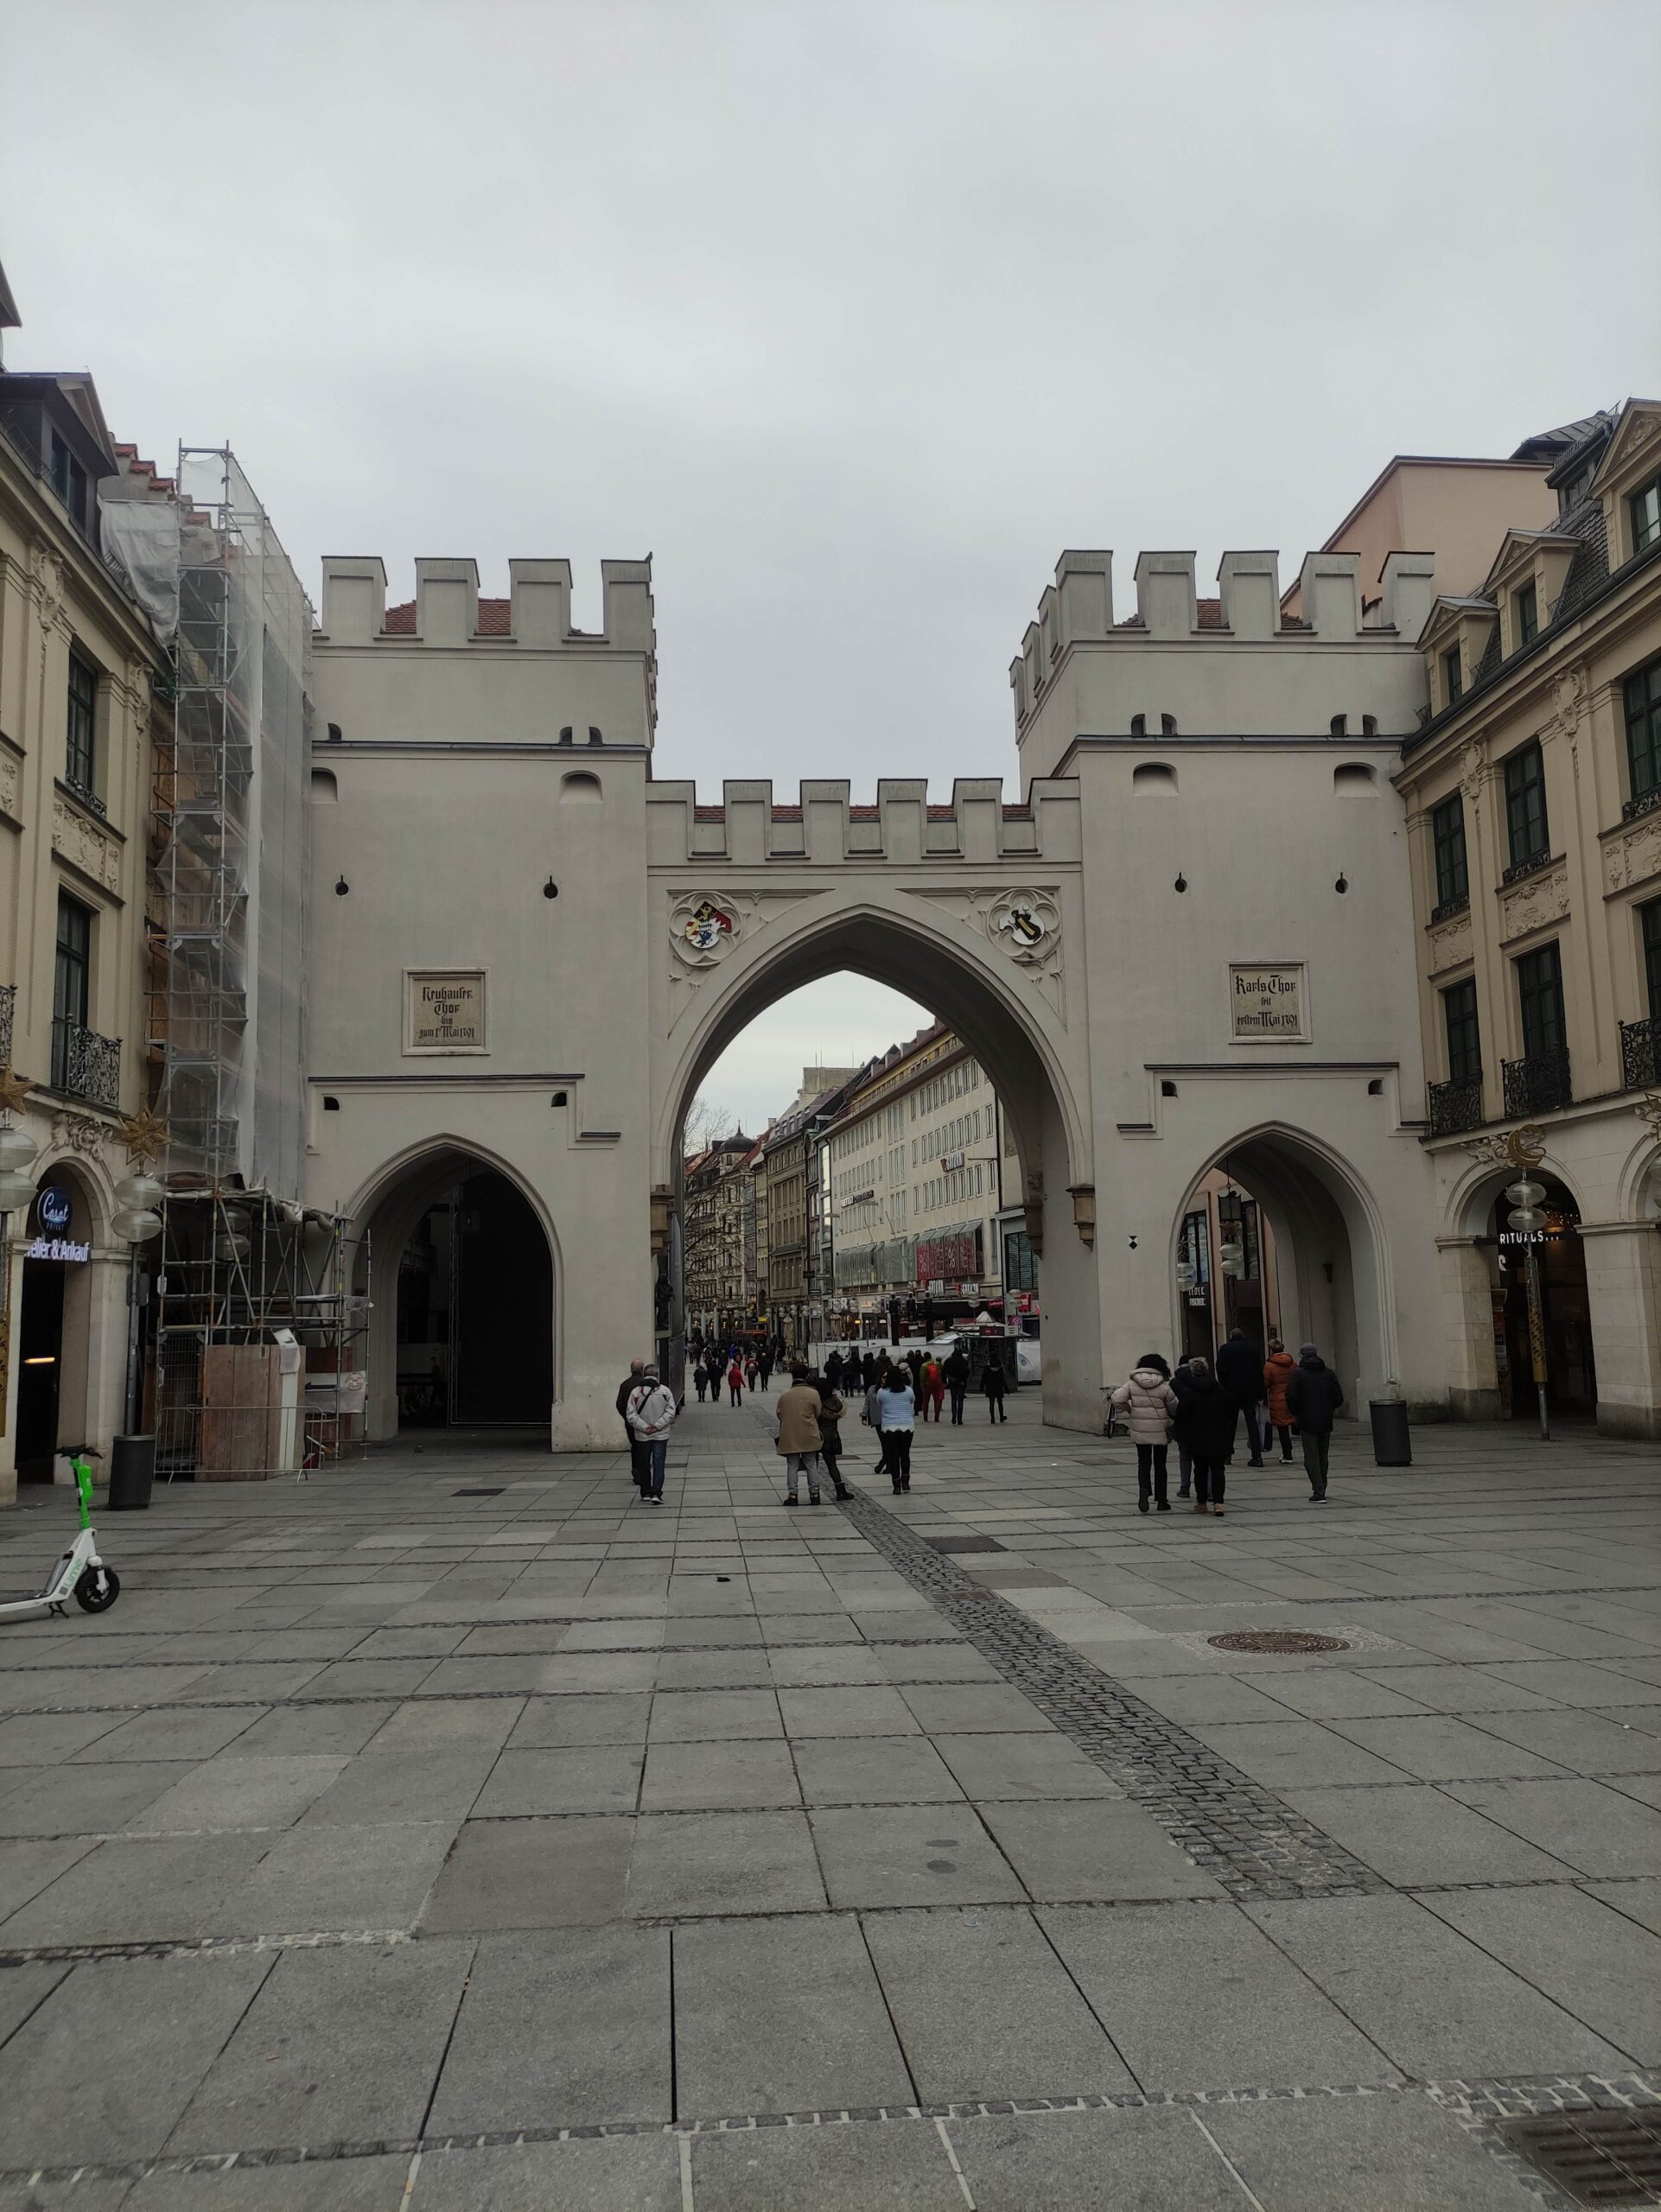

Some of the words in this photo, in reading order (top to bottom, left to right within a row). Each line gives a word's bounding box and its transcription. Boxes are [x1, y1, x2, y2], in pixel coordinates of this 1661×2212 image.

[1236, 975, 1267, 995] Karls
[1268, 975, 1296, 995] Thor
[434, 1001, 461, 1016] Thor
[60, 1240, 89, 1262] Ankauf
